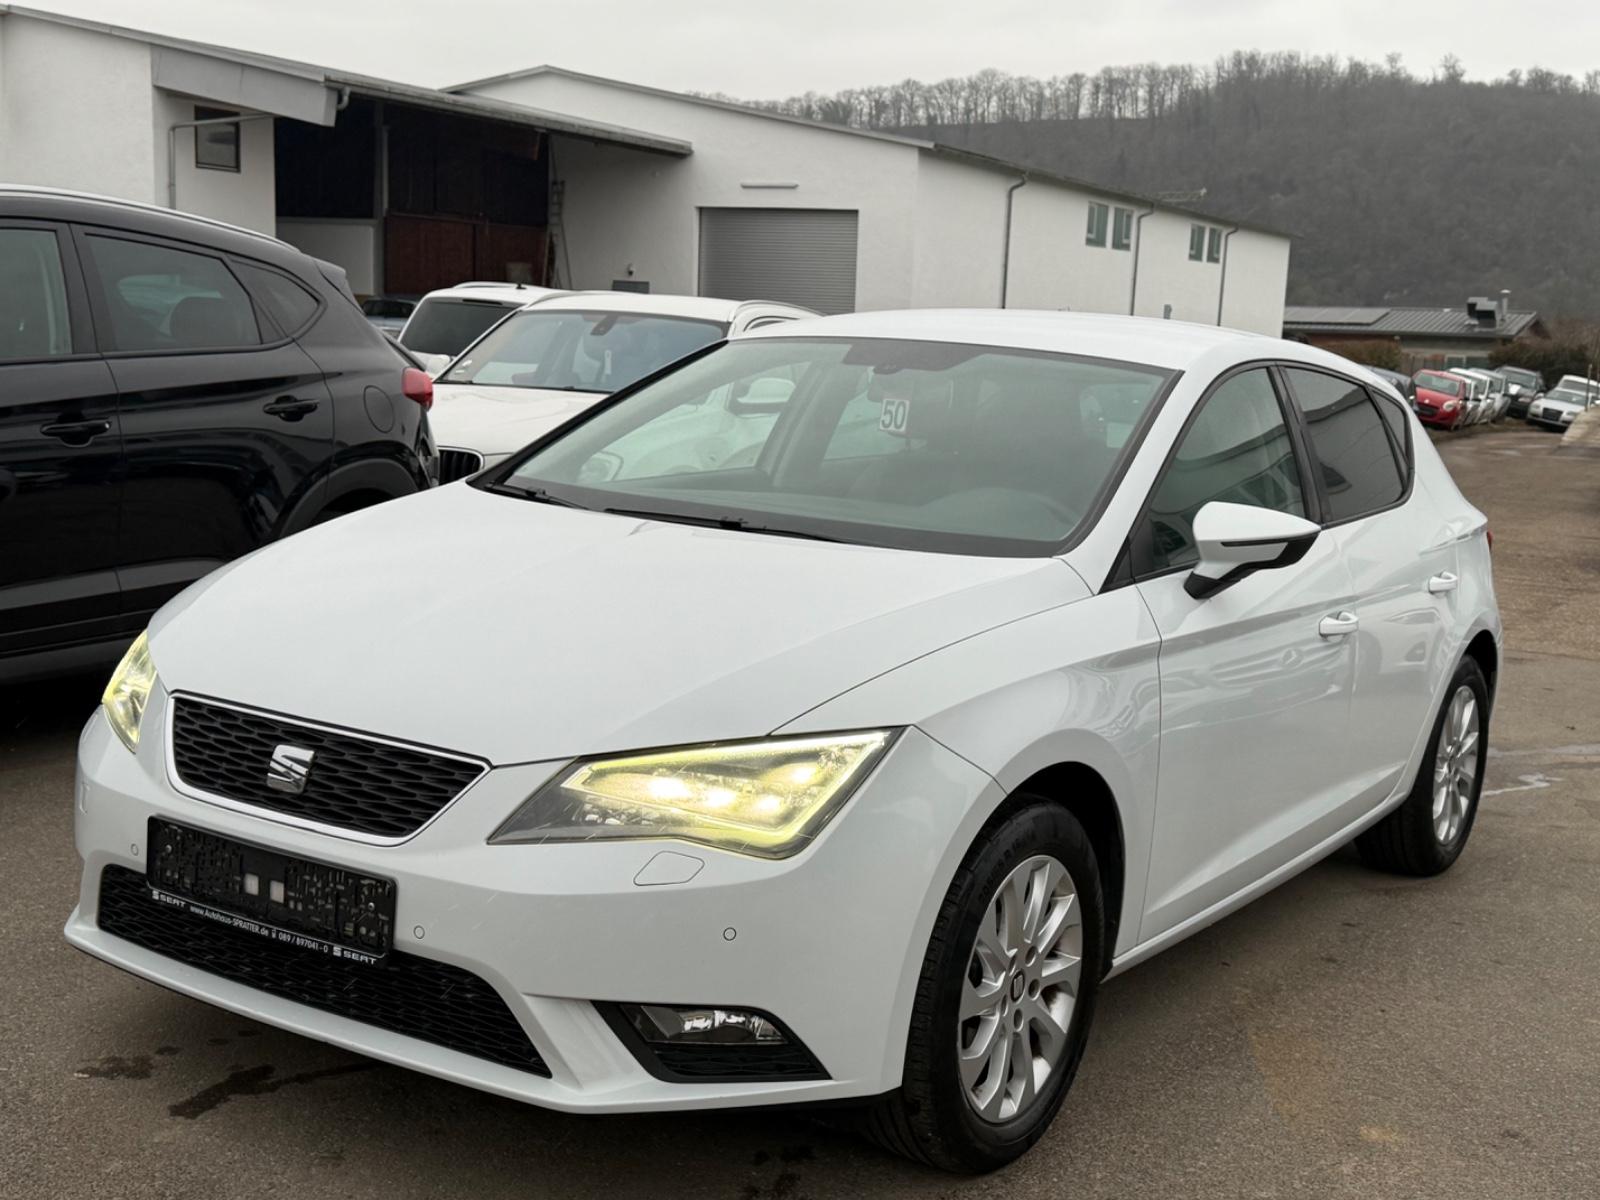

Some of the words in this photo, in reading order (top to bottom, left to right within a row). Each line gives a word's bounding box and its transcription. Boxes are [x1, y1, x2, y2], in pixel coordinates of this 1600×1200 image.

[881, 400, 906, 430] 50
[160, 894, 186, 908] SEAT
[343, 950, 377, 965] SEAT
